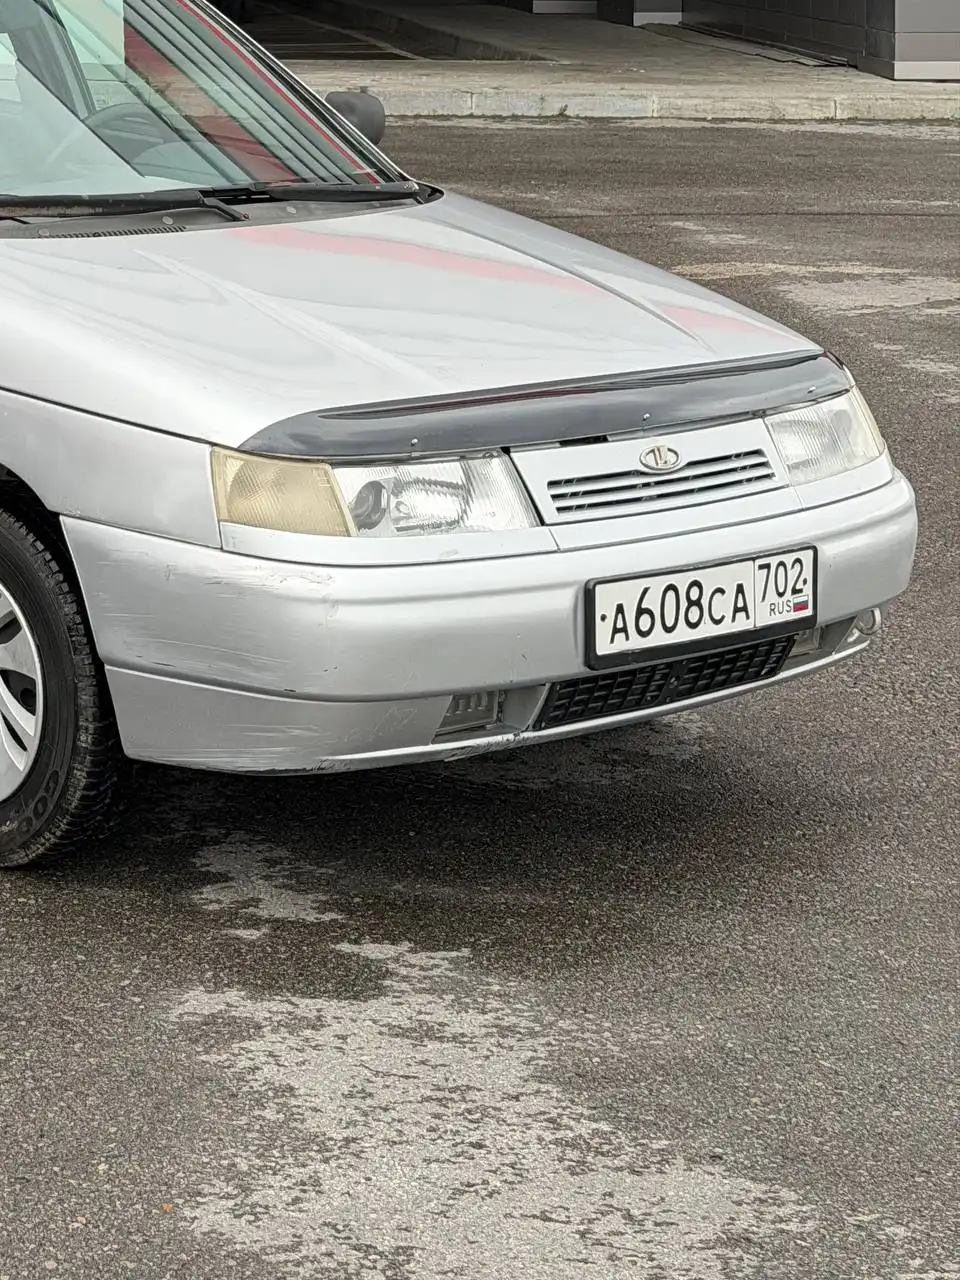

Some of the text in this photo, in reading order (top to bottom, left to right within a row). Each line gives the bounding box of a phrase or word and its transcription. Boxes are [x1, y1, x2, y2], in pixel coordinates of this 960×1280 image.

[609, 557, 804, 644] A608CA 702
[769, 599, 792, 617] RUS
